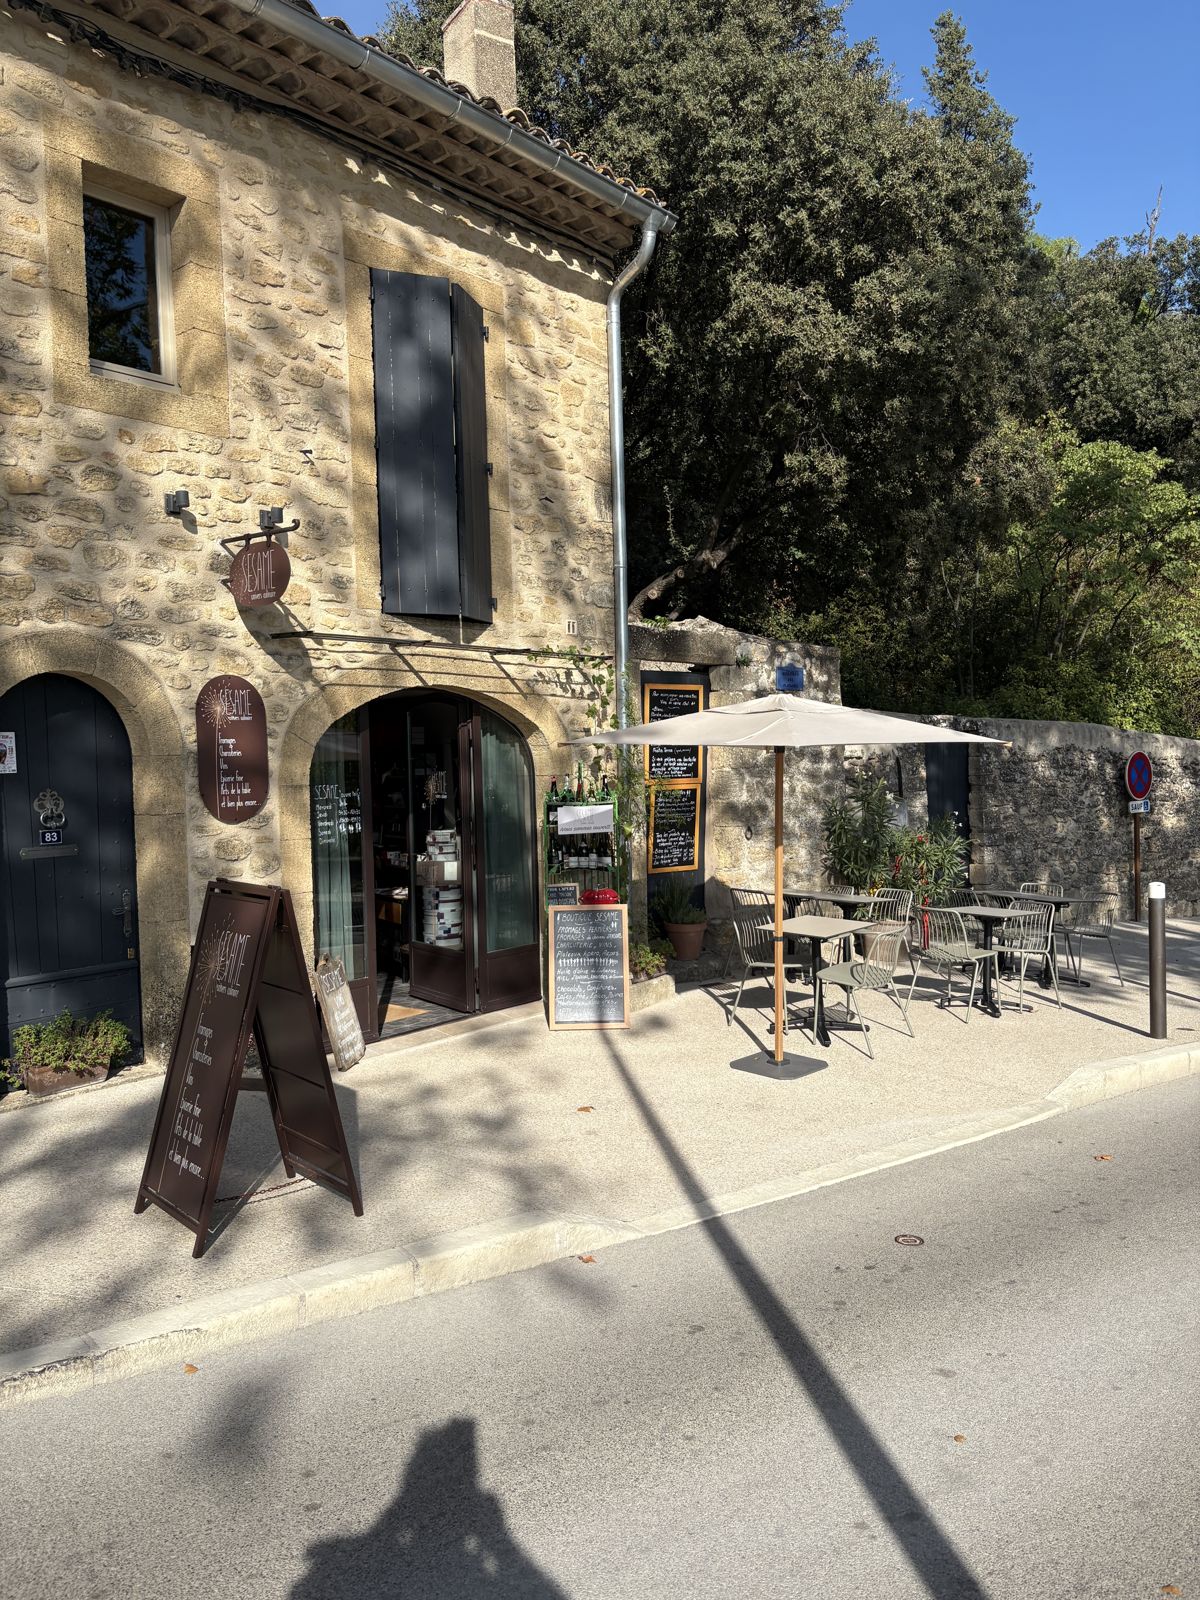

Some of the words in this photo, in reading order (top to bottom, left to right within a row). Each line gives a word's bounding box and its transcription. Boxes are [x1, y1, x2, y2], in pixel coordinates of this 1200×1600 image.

[241, 549, 277, 592] SESAME
[220, 689, 252, 716] SESAME
[1131, 803, 1143, 811] SAUF
[45, 832, 58, 842] 83
[594, 911, 618, 922] SESAME
[557, 926, 586, 934] FROMAGES
[556, 933, 585, 941] FROMAGES
